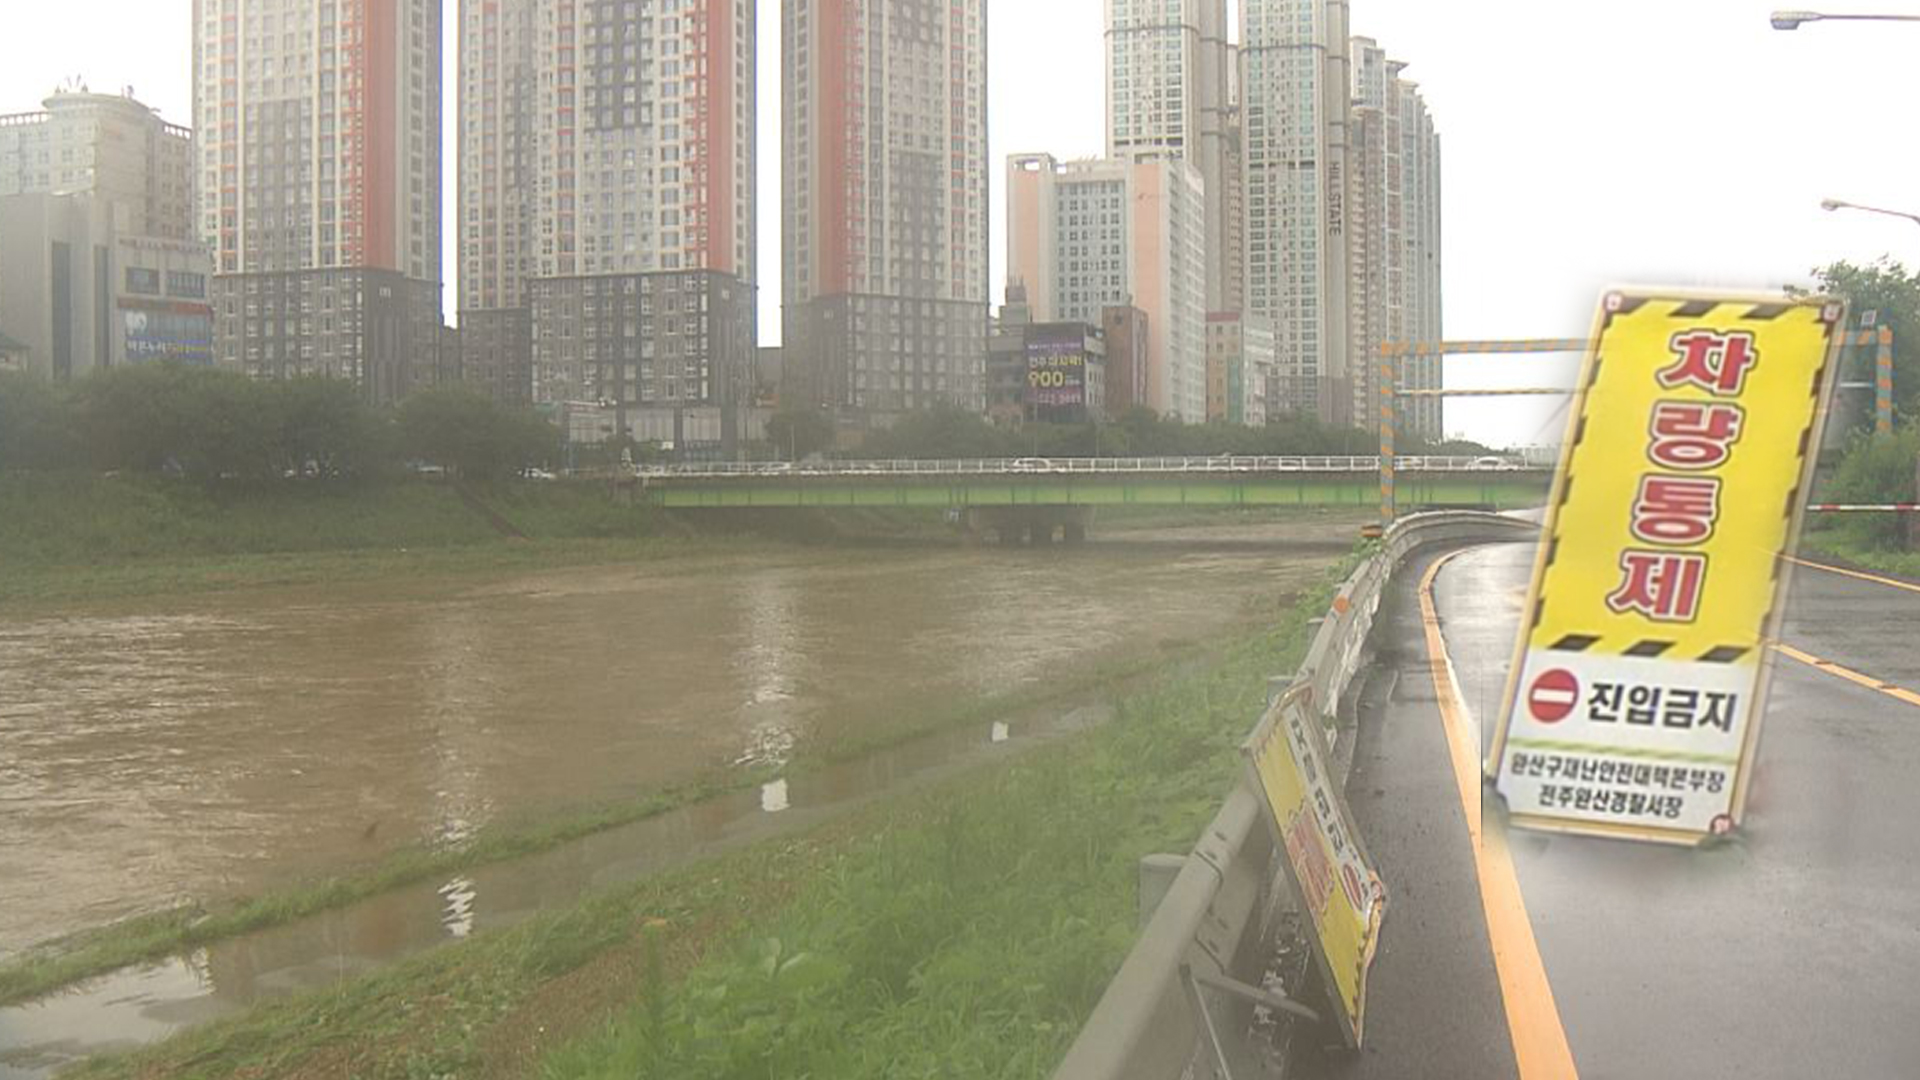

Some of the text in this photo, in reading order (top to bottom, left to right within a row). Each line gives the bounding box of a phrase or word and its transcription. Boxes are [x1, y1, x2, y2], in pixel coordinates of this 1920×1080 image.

[1028, 371, 1063, 388] 900
[1605, 327, 1758, 622] 차량통제
[1587, 682, 1737, 733] 진입금지
[1538, 783, 1684, 820] 전주완산경찰서장
